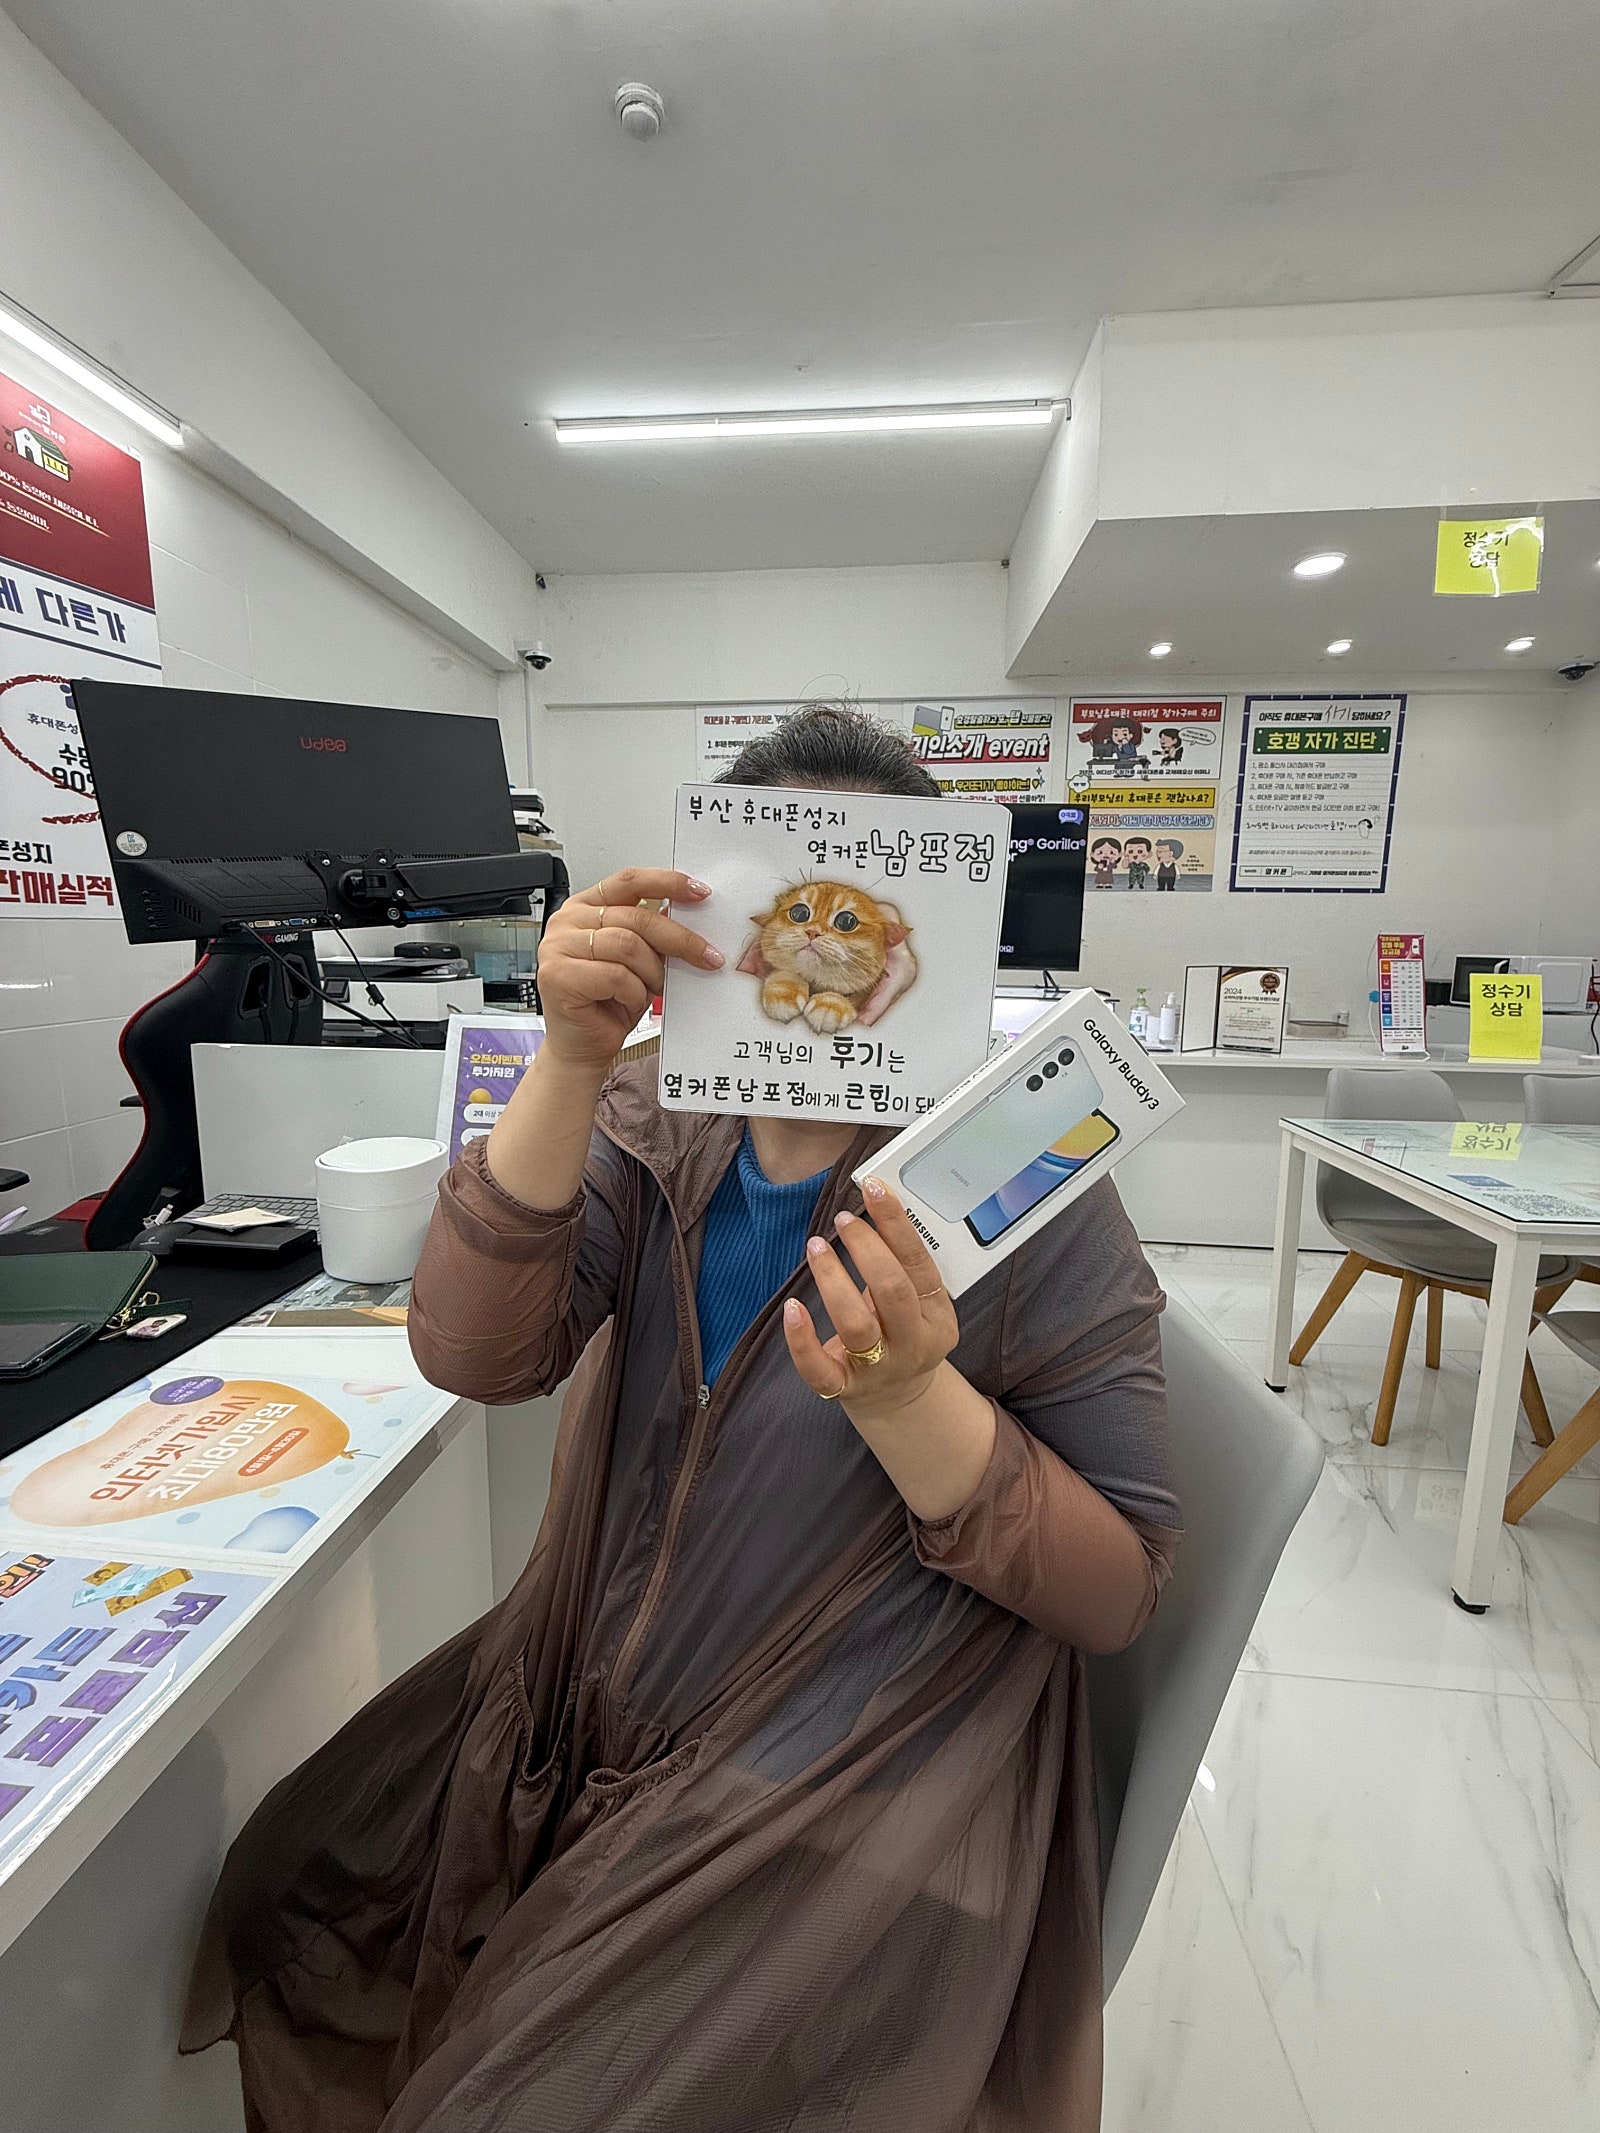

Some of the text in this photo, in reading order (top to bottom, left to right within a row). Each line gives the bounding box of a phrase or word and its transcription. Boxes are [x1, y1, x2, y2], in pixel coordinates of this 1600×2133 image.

[35, 588, 126, 643] 다른가
[1133, 709, 1159, 718] 대리점
[1201, 708, 1216, 717] 주의
[1259, 712, 1283, 721] 아직도
[1324, 704, 1351, 723] 사기
[912, 733, 1049, 759] 지인소개 event
[1267, 731, 1377, 750] 호갱 자가 진단
[1074, 793, 1124, 803] 우리부모님의
[1128, 793, 1162, 803] 휴대폰은
[689, 795, 846, 832] 부산 휴대폰성지
[275, 933, 298, 943] GAMING
[1481, 984, 1530, 998] 정수기
[1490, 1002, 1523, 1017] 상담
[733, 1035, 906, 1074] 고객님의 후기는
[1083, 1019, 1160, 1111] Galaxy Buddy3
[904, 1207, 940, 1251] SAMSUNG
[90, 1395, 261, 1501] 인터넷가입시
[146, 1402, 298, 1501] 최대80만원
